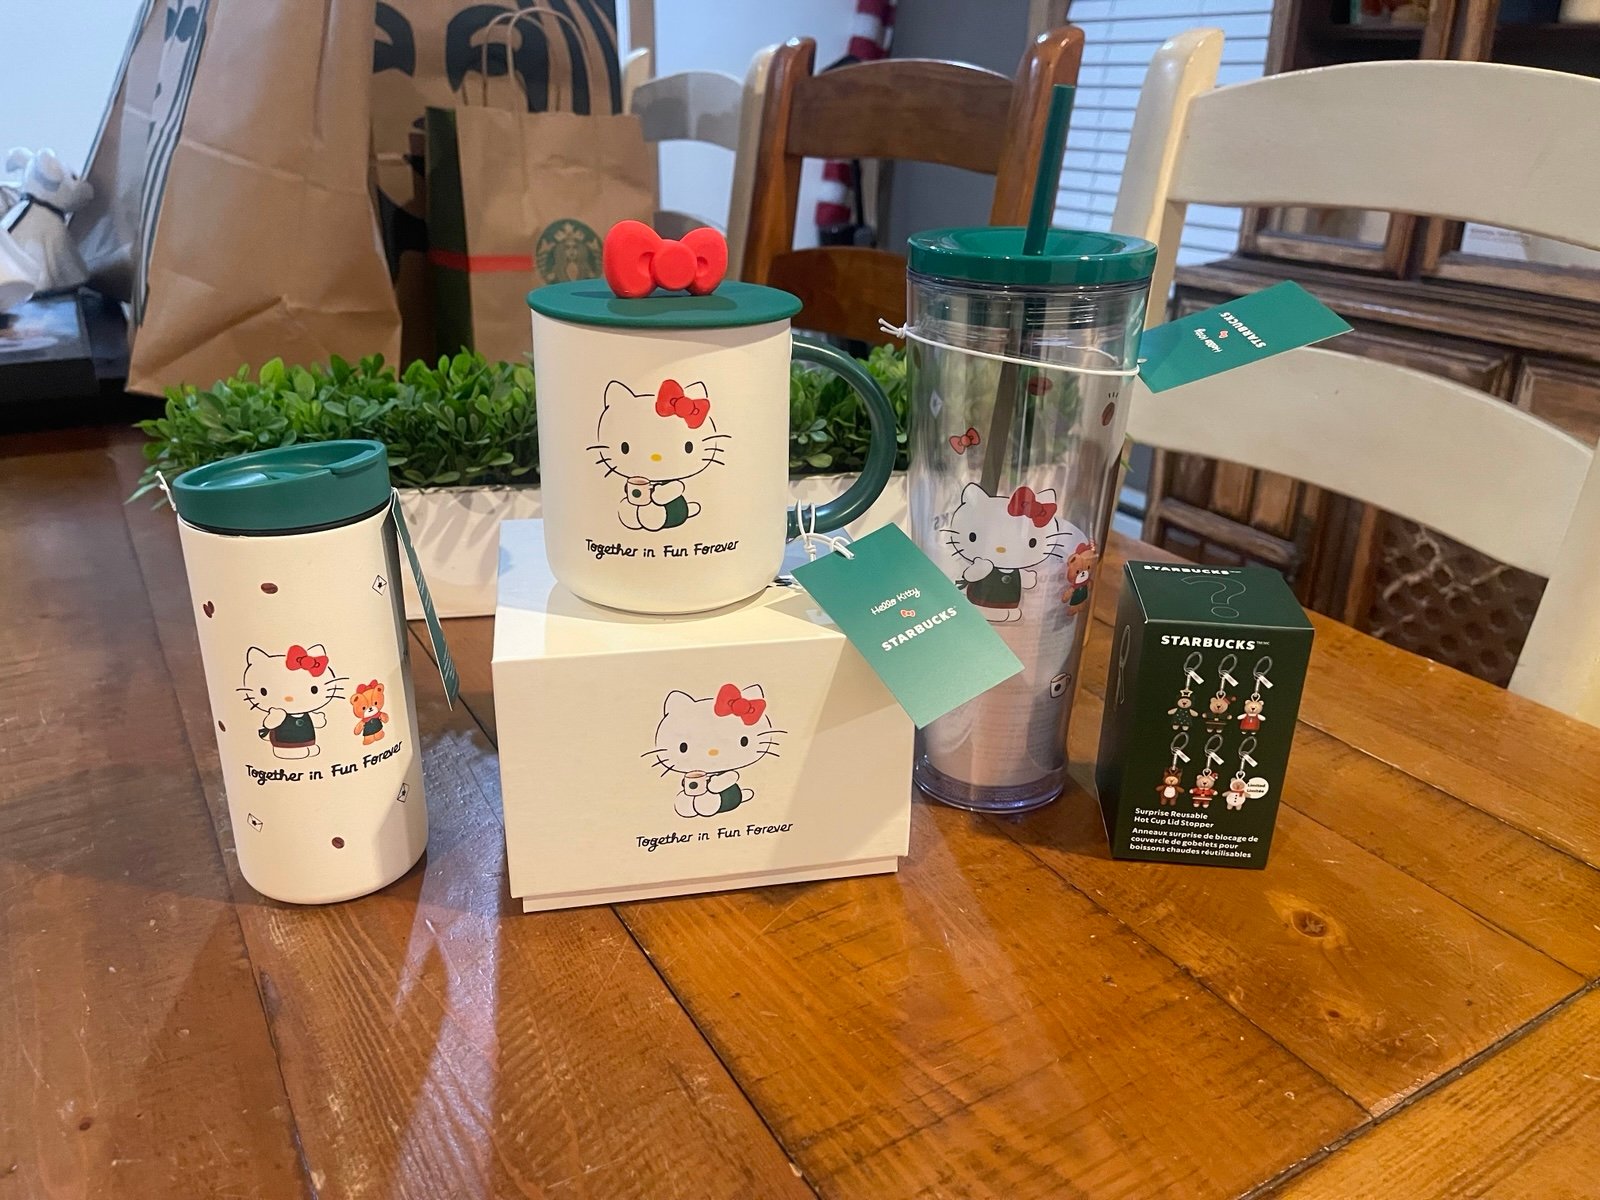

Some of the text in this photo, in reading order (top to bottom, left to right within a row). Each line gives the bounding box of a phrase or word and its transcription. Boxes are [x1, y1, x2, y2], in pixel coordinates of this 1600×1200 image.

[1220, 312, 1266, 348] STARBUCKS
[586, 539, 739, 560] Together in Fun Forever
[1144, 565, 1230, 575] STARBUCKS
[870, 588, 920, 616] Hello Kitty
[882, 607, 957, 652] STARBUCKS
[1160, 635, 1256, 650] STARBUCKS
[246, 740, 402, 786] Together in Fun Forever
[1134, 808, 1208, 820] Surprise Reusable
[1150, 817, 1166, 826] Cup
[1180, 820, 1214, 828] Stopper
[636, 822, 794, 852] Together in Fun Forever
[1130, 836, 1171, 845] couvercle
[1182, 839, 1218, 849] gobelets
[1132, 828, 1168, 836] Anneaux
[1169, 831, 1202, 840] surprise
[1215, 833, 1248, 843] blocage
[1130, 844, 1252, 858] boissons chaudes réutilisables
